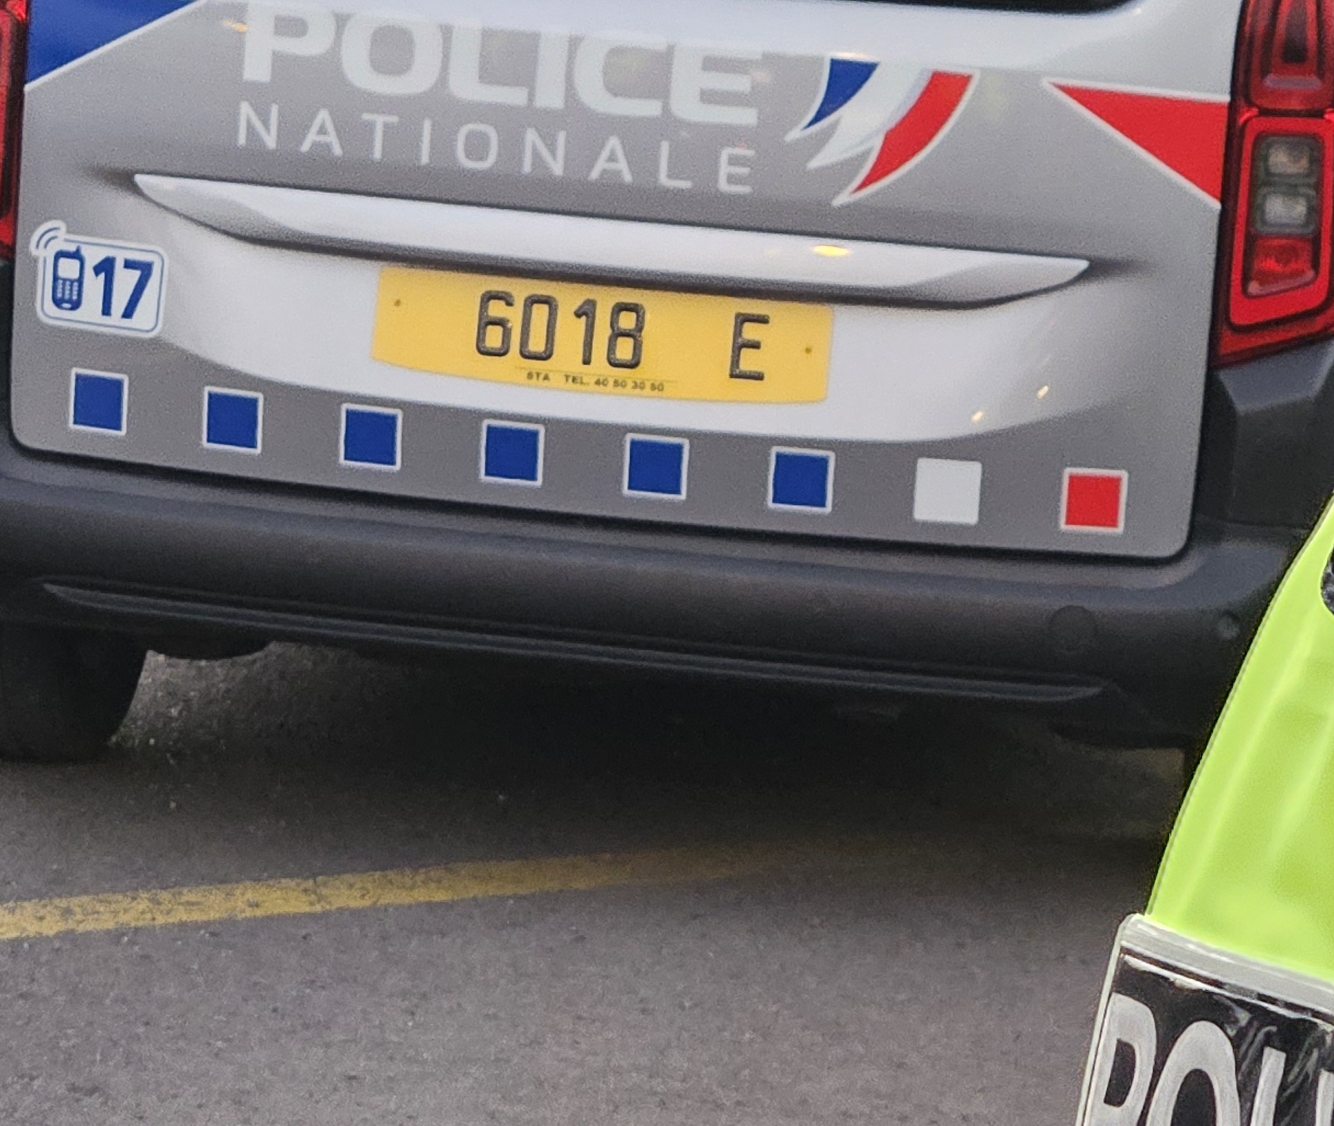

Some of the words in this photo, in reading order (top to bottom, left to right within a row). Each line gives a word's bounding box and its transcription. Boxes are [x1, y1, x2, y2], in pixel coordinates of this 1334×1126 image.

[243, 1, 760, 127] POLICE
[238, 100, 756, 195] NATIONALE
[92, 255, 154, 320] 17
[475, 290, 646, 369] 6018
[729, 312, 770, 381] E
